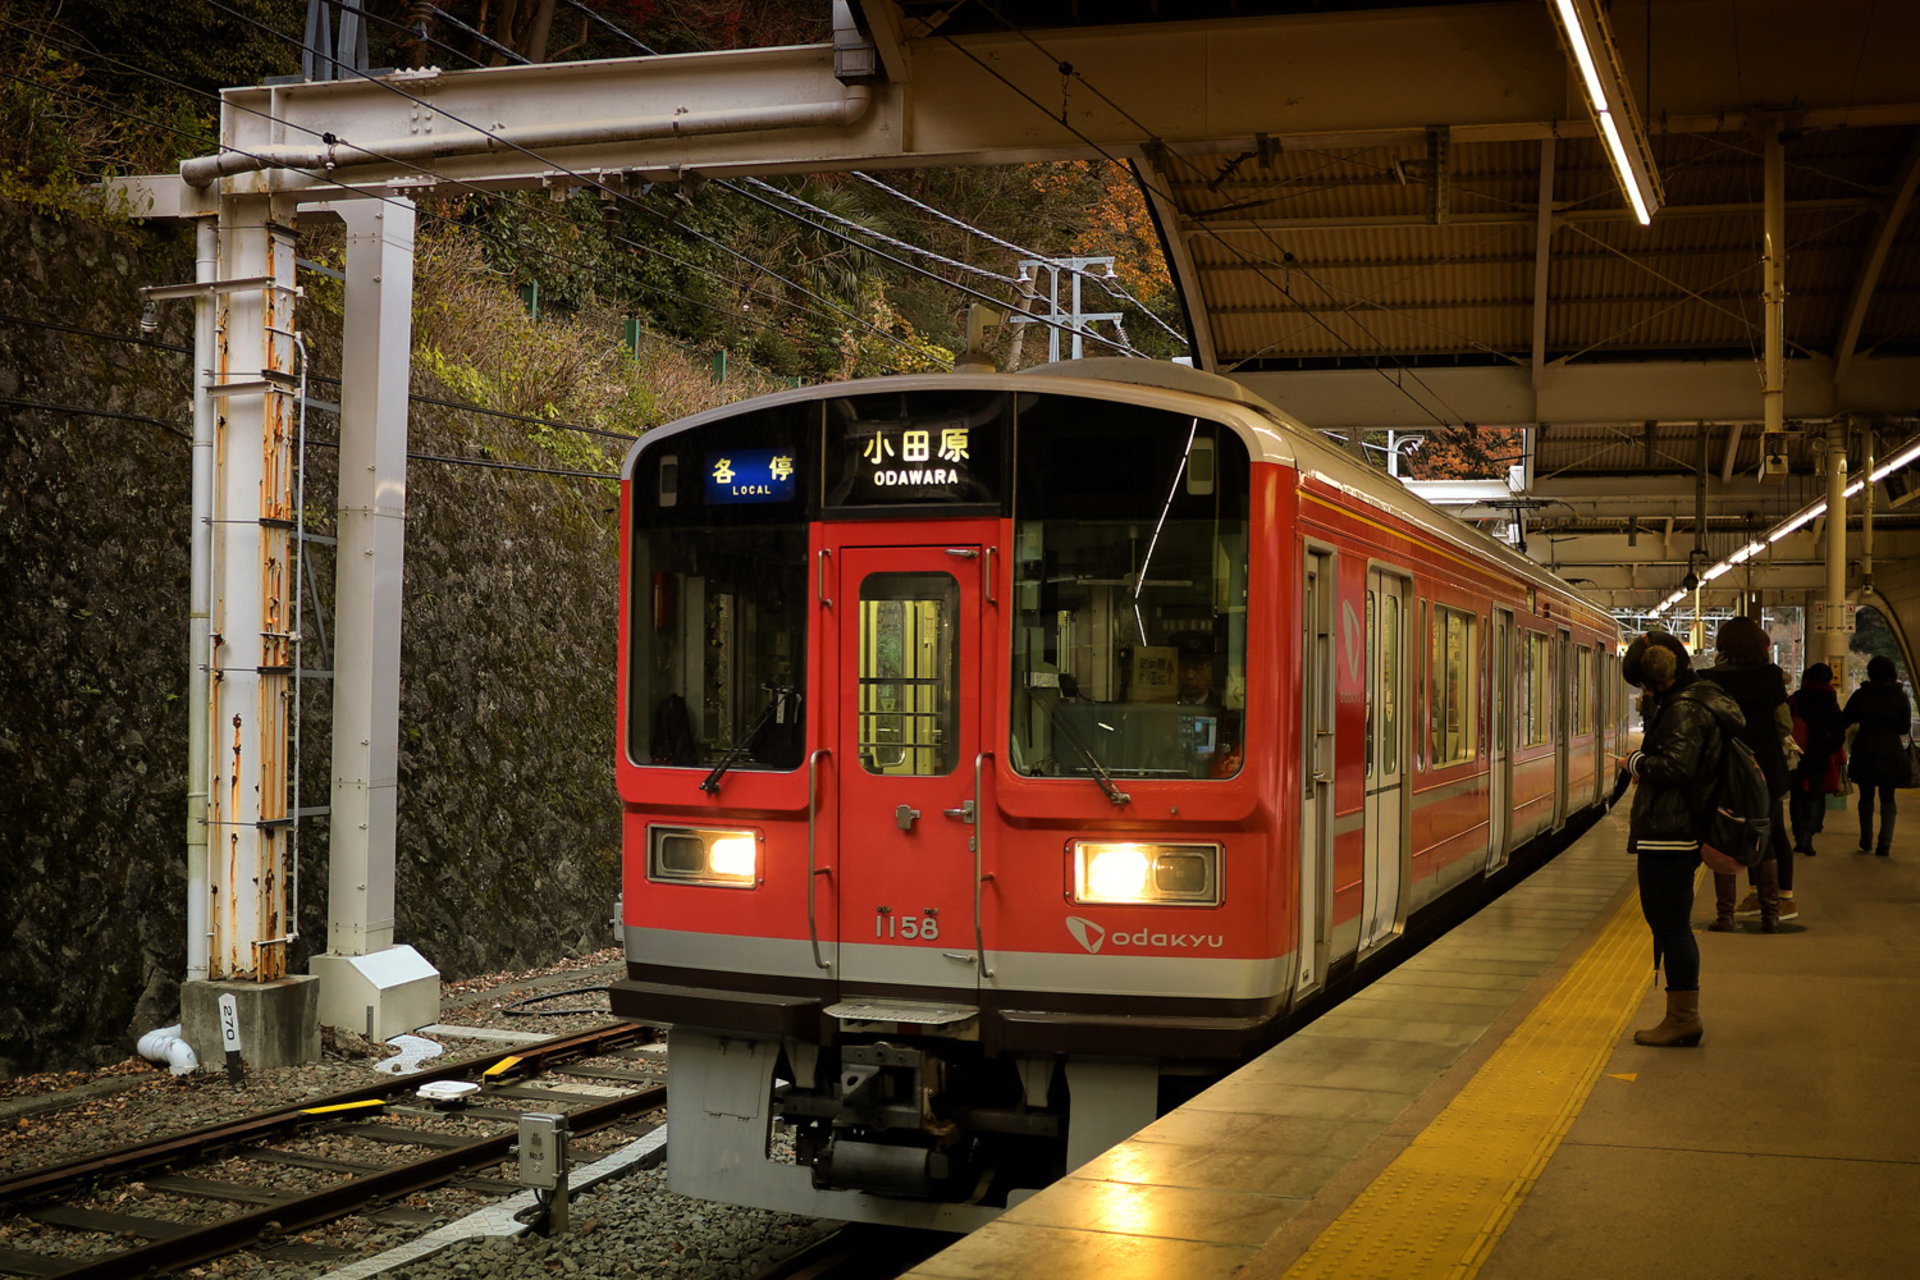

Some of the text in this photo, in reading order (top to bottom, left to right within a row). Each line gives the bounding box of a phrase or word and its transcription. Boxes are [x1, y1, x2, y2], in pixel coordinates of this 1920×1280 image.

[863, 428, 970, 464] 小田原
[712, 455, 794, 485] 各停
[874, 469, 958, 486] ODAWARA
[732, 485, 772, 496] LOCAL
[876, 915, 939, 940] 1158
[1111, 928, 1224, 948] odakyu
[224, 1005, 235, 1040] 270
